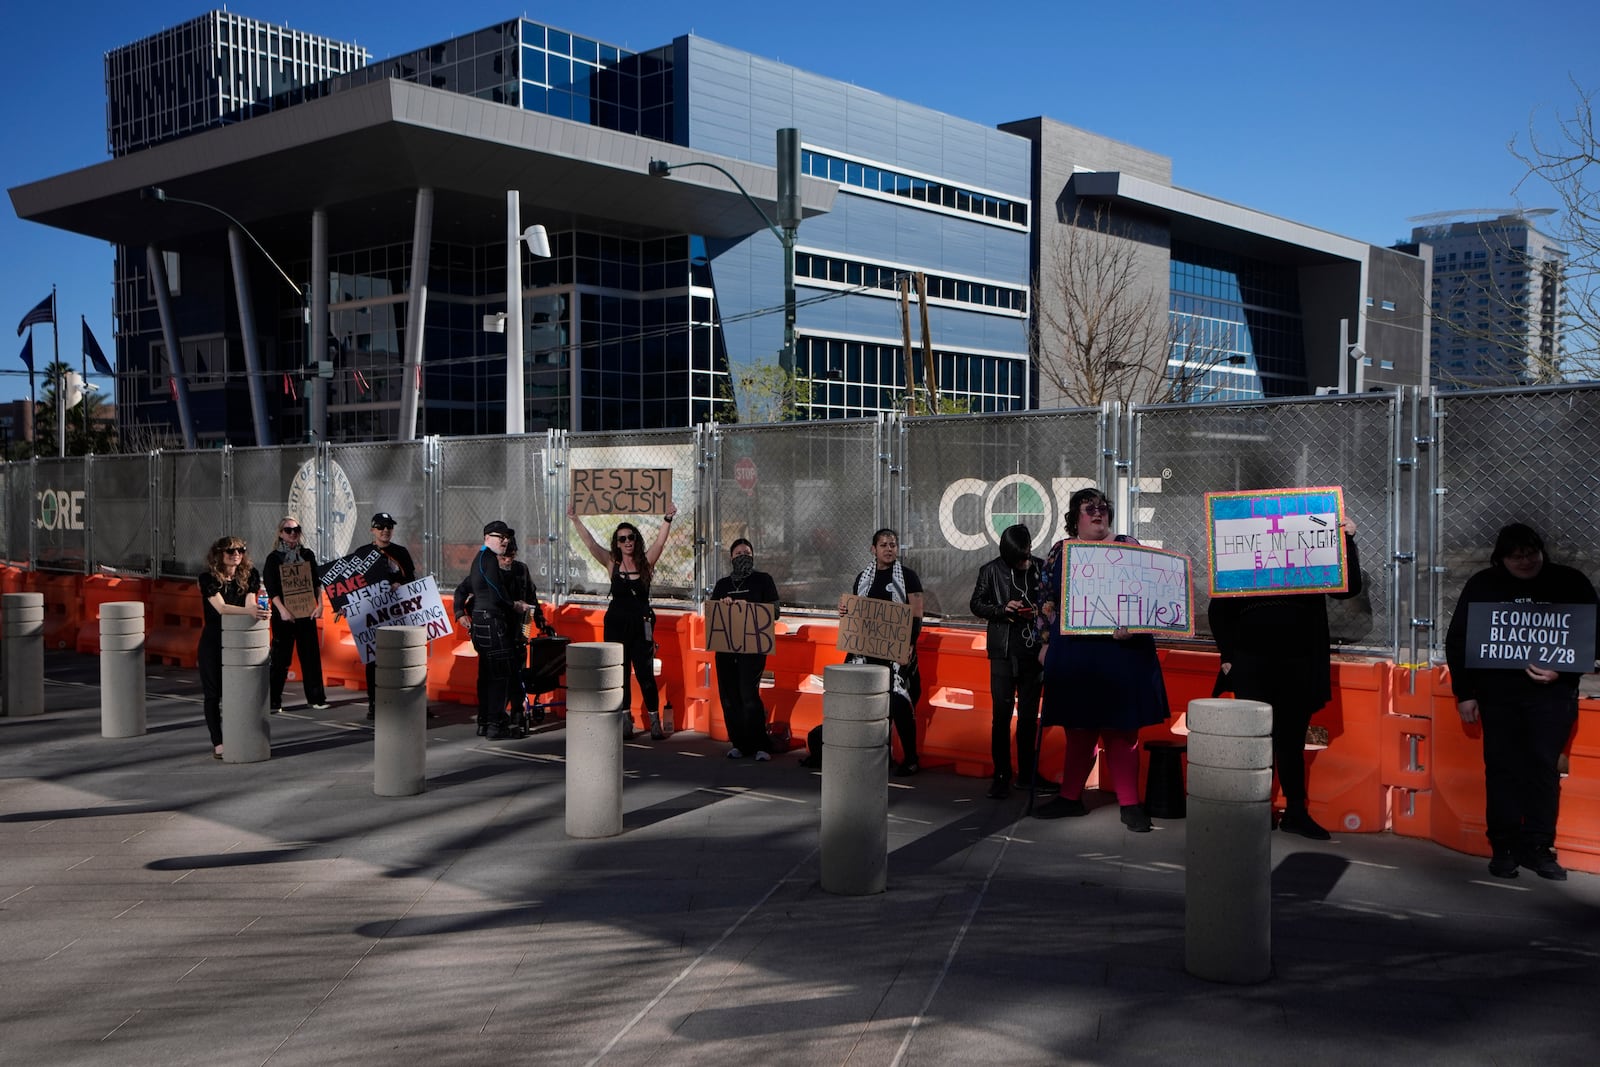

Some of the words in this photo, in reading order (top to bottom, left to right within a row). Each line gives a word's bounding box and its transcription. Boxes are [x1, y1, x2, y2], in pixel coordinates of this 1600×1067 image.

[300, 465, 312, 481] OF
[573, 469, 667, 491] RESIST
[736, 467, 755, 481] STOP
[572, 491, 667, 514] FASCISM
[1266, 515, 1285, 534] I
[1224, 534, 1262, 555] HAVE
[1271, 532, 1289, 551] MY
[342, 556, 362, 579] THIS
[356, 550, 381, 576] WERE
[1254, 548, 1315, 569] BACK
[282, 564, 303, 578] EAT
[326, 559, 348, 581] WISH
[326, 574, 369, 599] FAKE
[346, 579, 391, 604] NEWS
[1119, 578, 1143, 595] TO
[348, 602, 361, 618] IF
[408, 579, 428, 596] NOT
[365, 595, 423, 629] ANGRY
[410, 605, 444, 626] PAYING
[847, 597, 911, 626] CAPITALISM
[1491, 610, 1572, 629] ECONOMIC
[707, 602, 774, 655] ACAB
[845, 616, 860, 633] IS
[862, 620, 907, 643] MAKING
[1490, 627, 1570, 646] BLACKOUT
[843, 632, 865, 651] YOU
[1480, 644, 1532, 660] FRIDAY
[1539, 646, 1575, 664] 2/28
